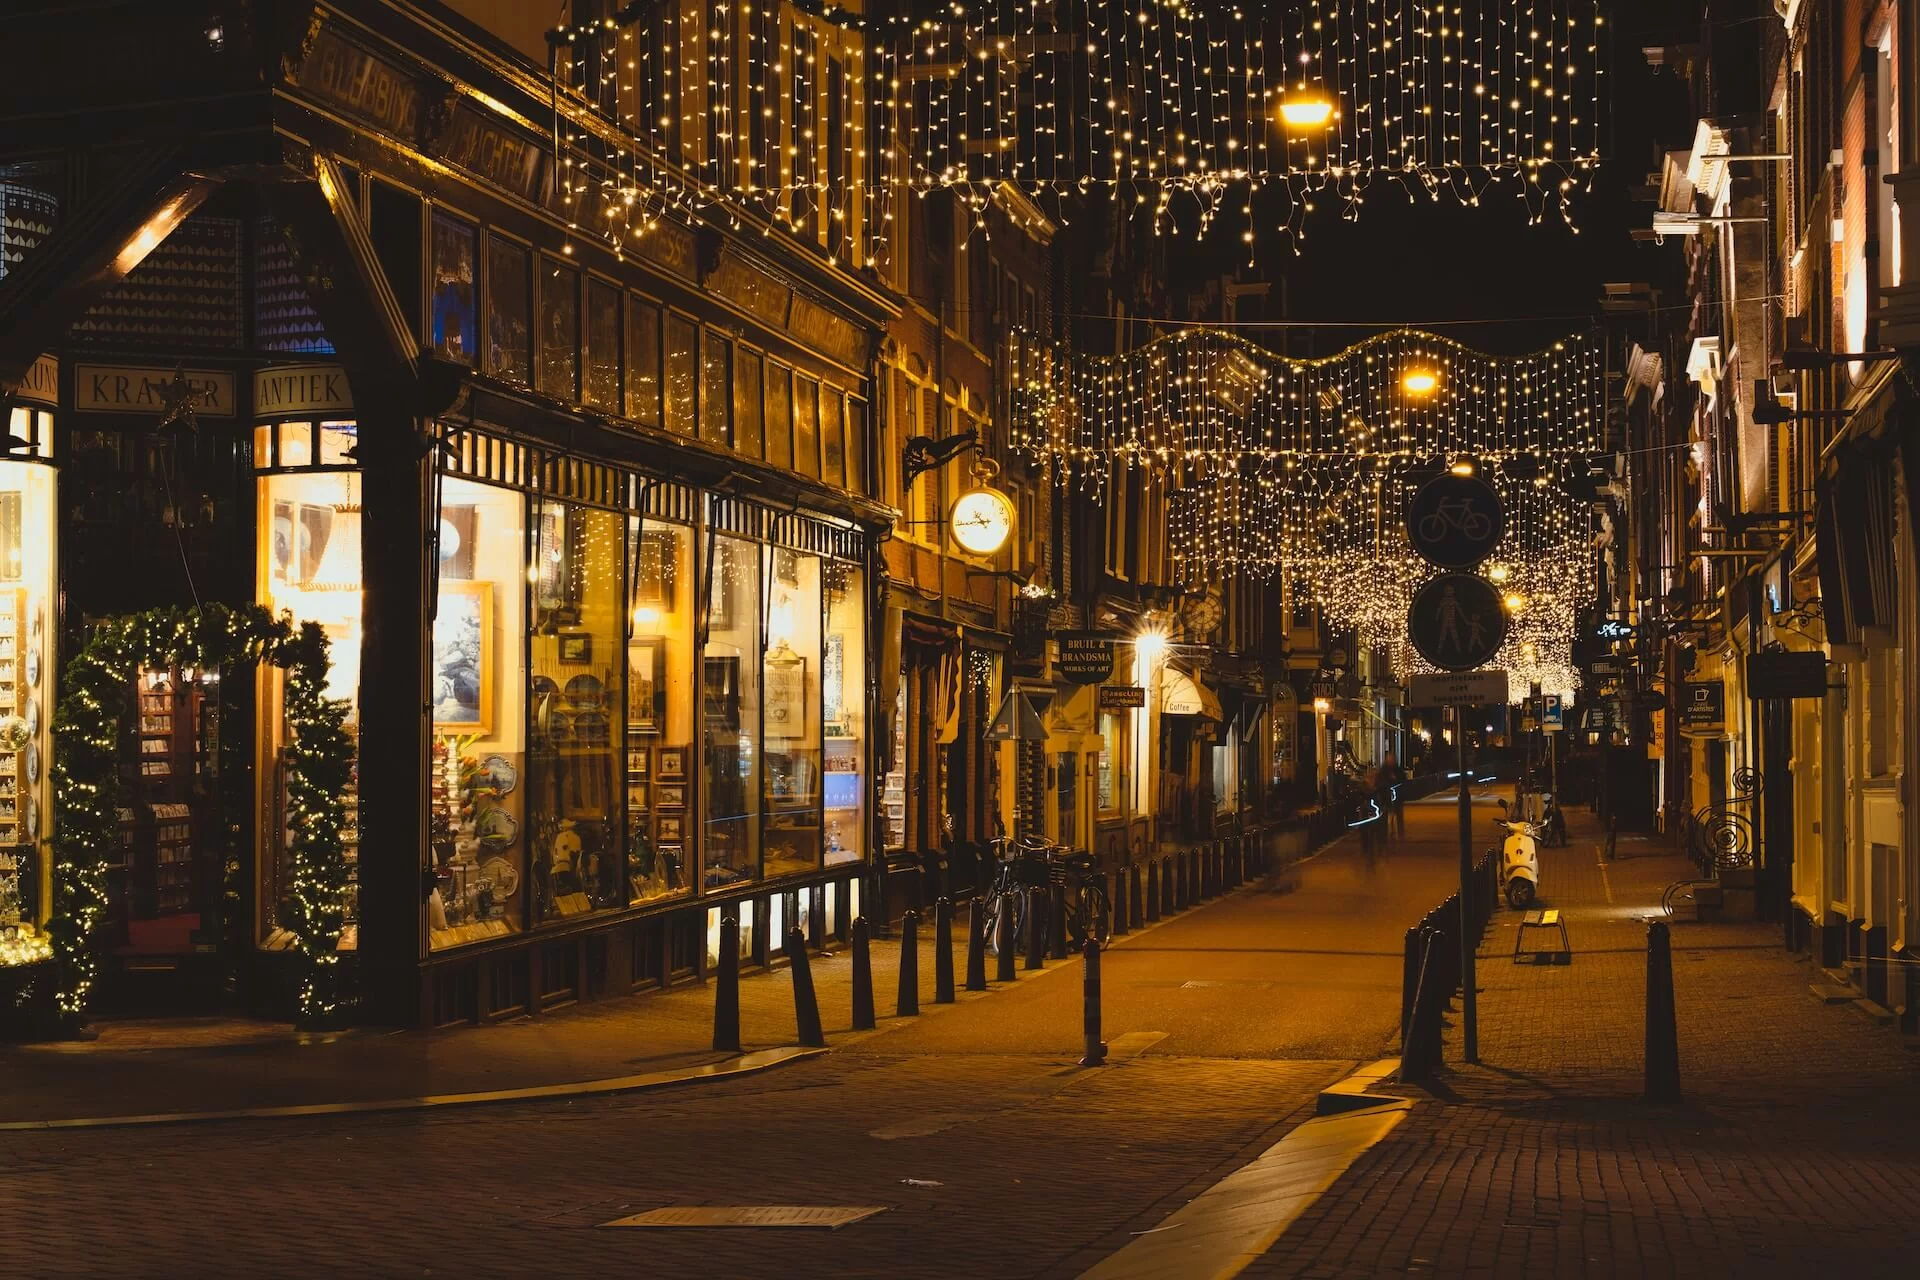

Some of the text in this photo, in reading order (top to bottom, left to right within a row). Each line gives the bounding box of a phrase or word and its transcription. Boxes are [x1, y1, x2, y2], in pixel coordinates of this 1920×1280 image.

[94, 374, 219, 408] KRAER
[260, 373, 341, 407] ANTIEK
[1068, 640, 1106, 649] BRUIL &
[1062, 652, 1112, 662] BRANDSMA
[1169, 703, 1190, 712] Coffee
[1546, 696, 1558, 713] P
[1655, 732, 1664, 740] 50
